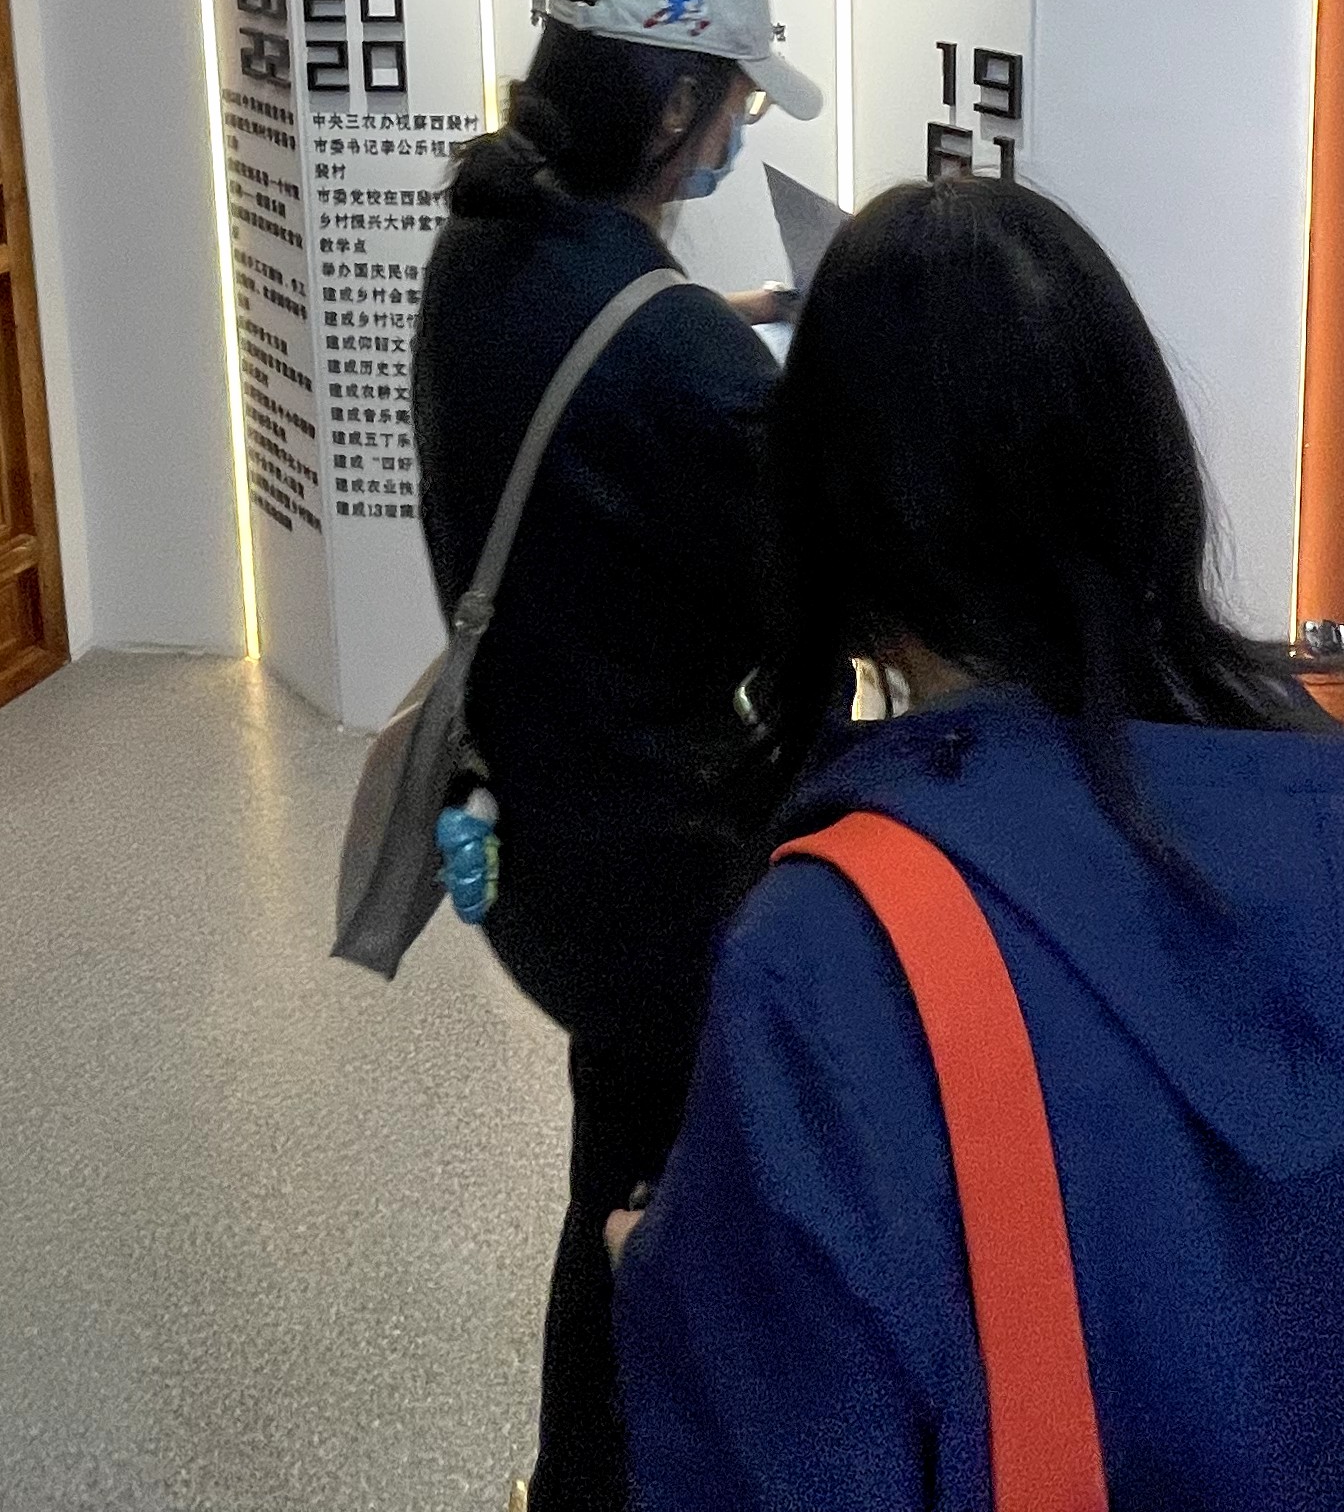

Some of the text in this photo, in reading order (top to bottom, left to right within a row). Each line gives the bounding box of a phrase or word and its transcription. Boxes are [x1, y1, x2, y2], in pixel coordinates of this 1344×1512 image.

[305, 40, 407, 92] 20
[936, 41, 1023, 119] 19
[313, 113, 479, 131] 中央三农办视察西裴村
[313, 139, 458, 157] 市委书记李公乐视
